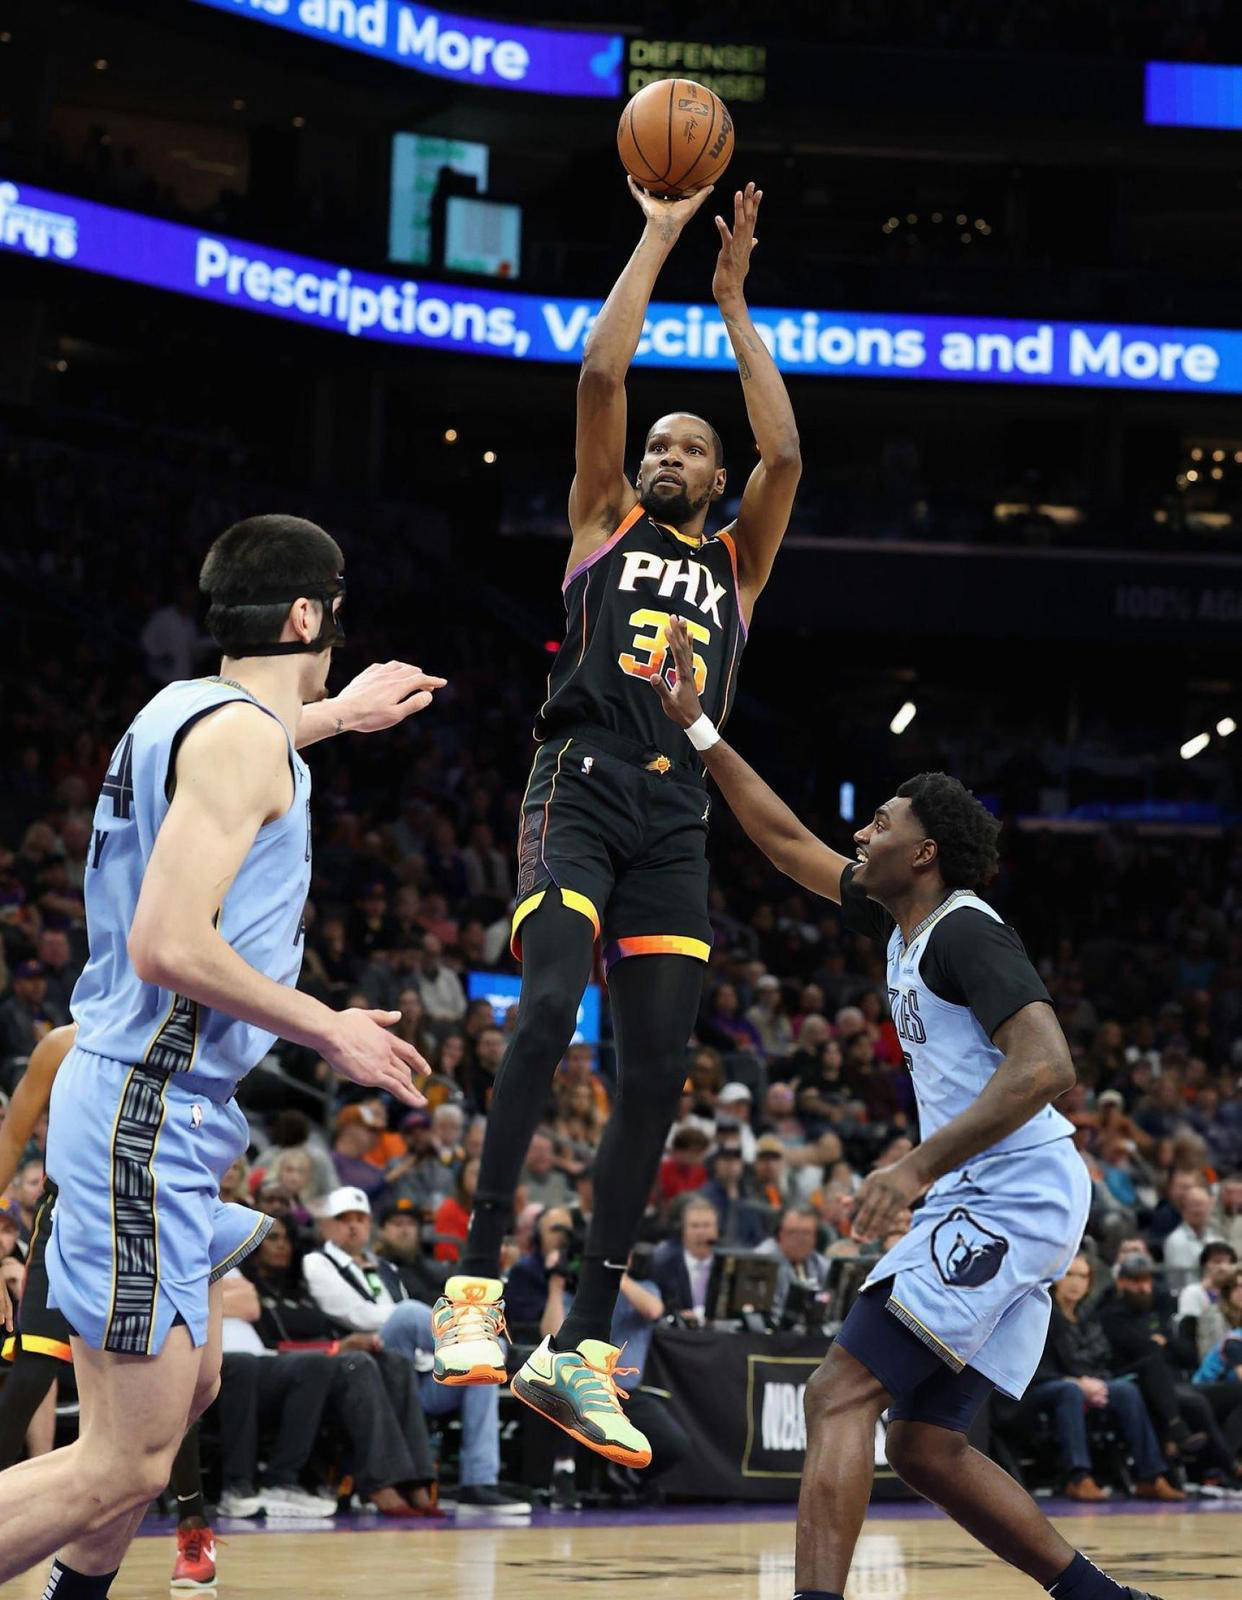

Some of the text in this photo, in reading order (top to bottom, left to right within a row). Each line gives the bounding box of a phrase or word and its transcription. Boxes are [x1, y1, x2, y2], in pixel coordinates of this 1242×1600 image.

[299, 0, 529, 81] and More
[629, 39, 766, 72] DEFENSE!
[195, 237, 531, 357] Prescriptions,
[541, 303, 925, 368] Vccintions
[939, 325, 1053, 374] and
[1069, 329, 1220, 383] More
[618, 551, 727, 630] PHX
[618, 608, 711, 697] 35
